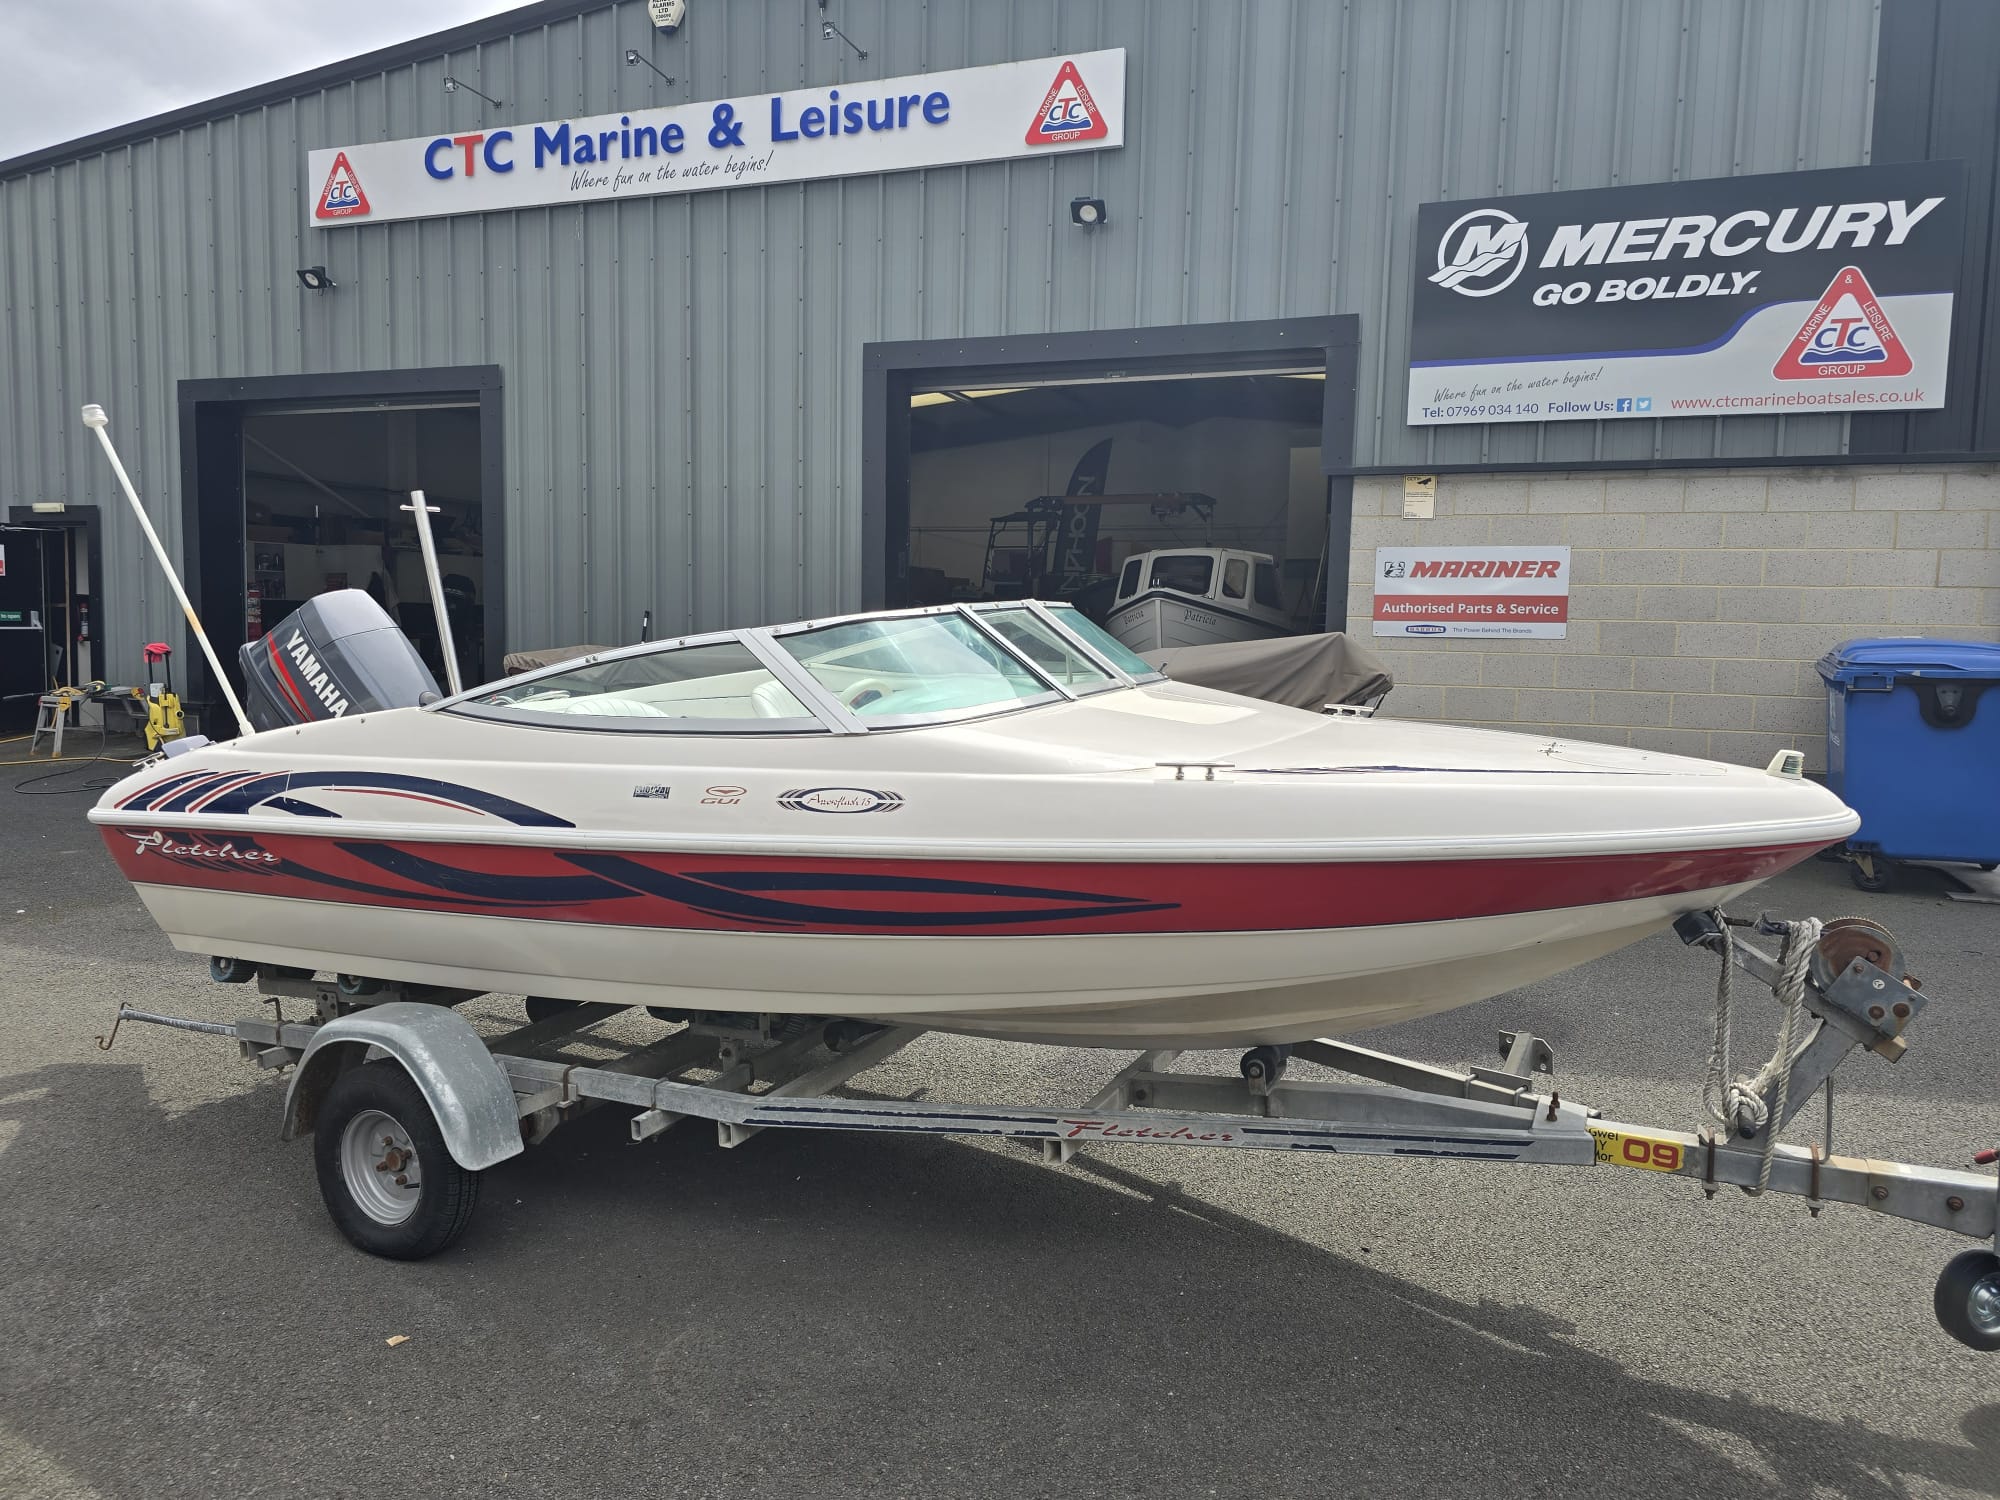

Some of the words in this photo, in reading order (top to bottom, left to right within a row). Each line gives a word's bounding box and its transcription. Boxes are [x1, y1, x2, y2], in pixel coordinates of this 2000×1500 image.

[1039, 88, 1058, 117] MARINE
[1048, 97, 1081, 120] CTC
[1077, 85, 1096, 114] LEISURE
[424, 131, 514, 180] CTC
[534, 116, 685, 168] Marine
[708, 103, 745, 149] &
[770, 89, 950, 143] Leisure
[1051, 131, 1080, 141] GROUP
[571, 168, 609, 192] Where
[613, 166, 633, 192] fun
[638, 171, 651, 183] on
[656, 162, 677, 180] the
[682, 163, 720, 178] water
[725, 150, 774, 180] begins!
[330, 181, 352, 199] CTC
[1538, 196, 1946, 270] MERCURY
[1532, 278, 1594, 307] GO
[1595, 269, 1761, 303] BOLDLY.
[1844, 274, 1853, 284] &
[1799, 303, 1831, 343] MARINE
[1814, 317, 1869, 348] CTC
[1862, 300, 1894, 342] LEISURE
[1818, 364, 1866, 377] GROUP
[1434, 388, 1466, 403] Where
[1470, 384, 1487, 402] fun
[1491, 387, 1502, 395] on
[1506, 379, 1523, 392] the
[1527, 376, 1559, 389] water
[1563, 366, 1604, 389] begins!
[1422, 406, 1444, 418] Tel:
[1446, 404, 1487, 417] 07969
[1488, 403, 1511, 416] 034
[1515, 402, 1539, 415] 140
[1548, 400, 1591, 414] Follow
[1593, 400, 1615, 412] Us:
[1670, 387, 1926, 410] www.ctcmarineboatsales.co.uk
[1409, 561, 1561, 578] MARINER
[1184, 608, 1217, 626] Patricia
[1382, 602, 1453, 614] Authorised
[1458, 603, 1492, 614] Parts
[1496, 603, 1506, 614] &
[1510, 603, 1559, 615] Service
[285, 629, 349, 718] YAMAHA
[861, 798, 871, 807] 15
[126, 831, 279, 862] Fletcher
[1063, 1119, 1235, 1141] Fletcher
[1599, 1140, 1607, 1150] Y
[1623, 1138, 1679, 1169] 09
